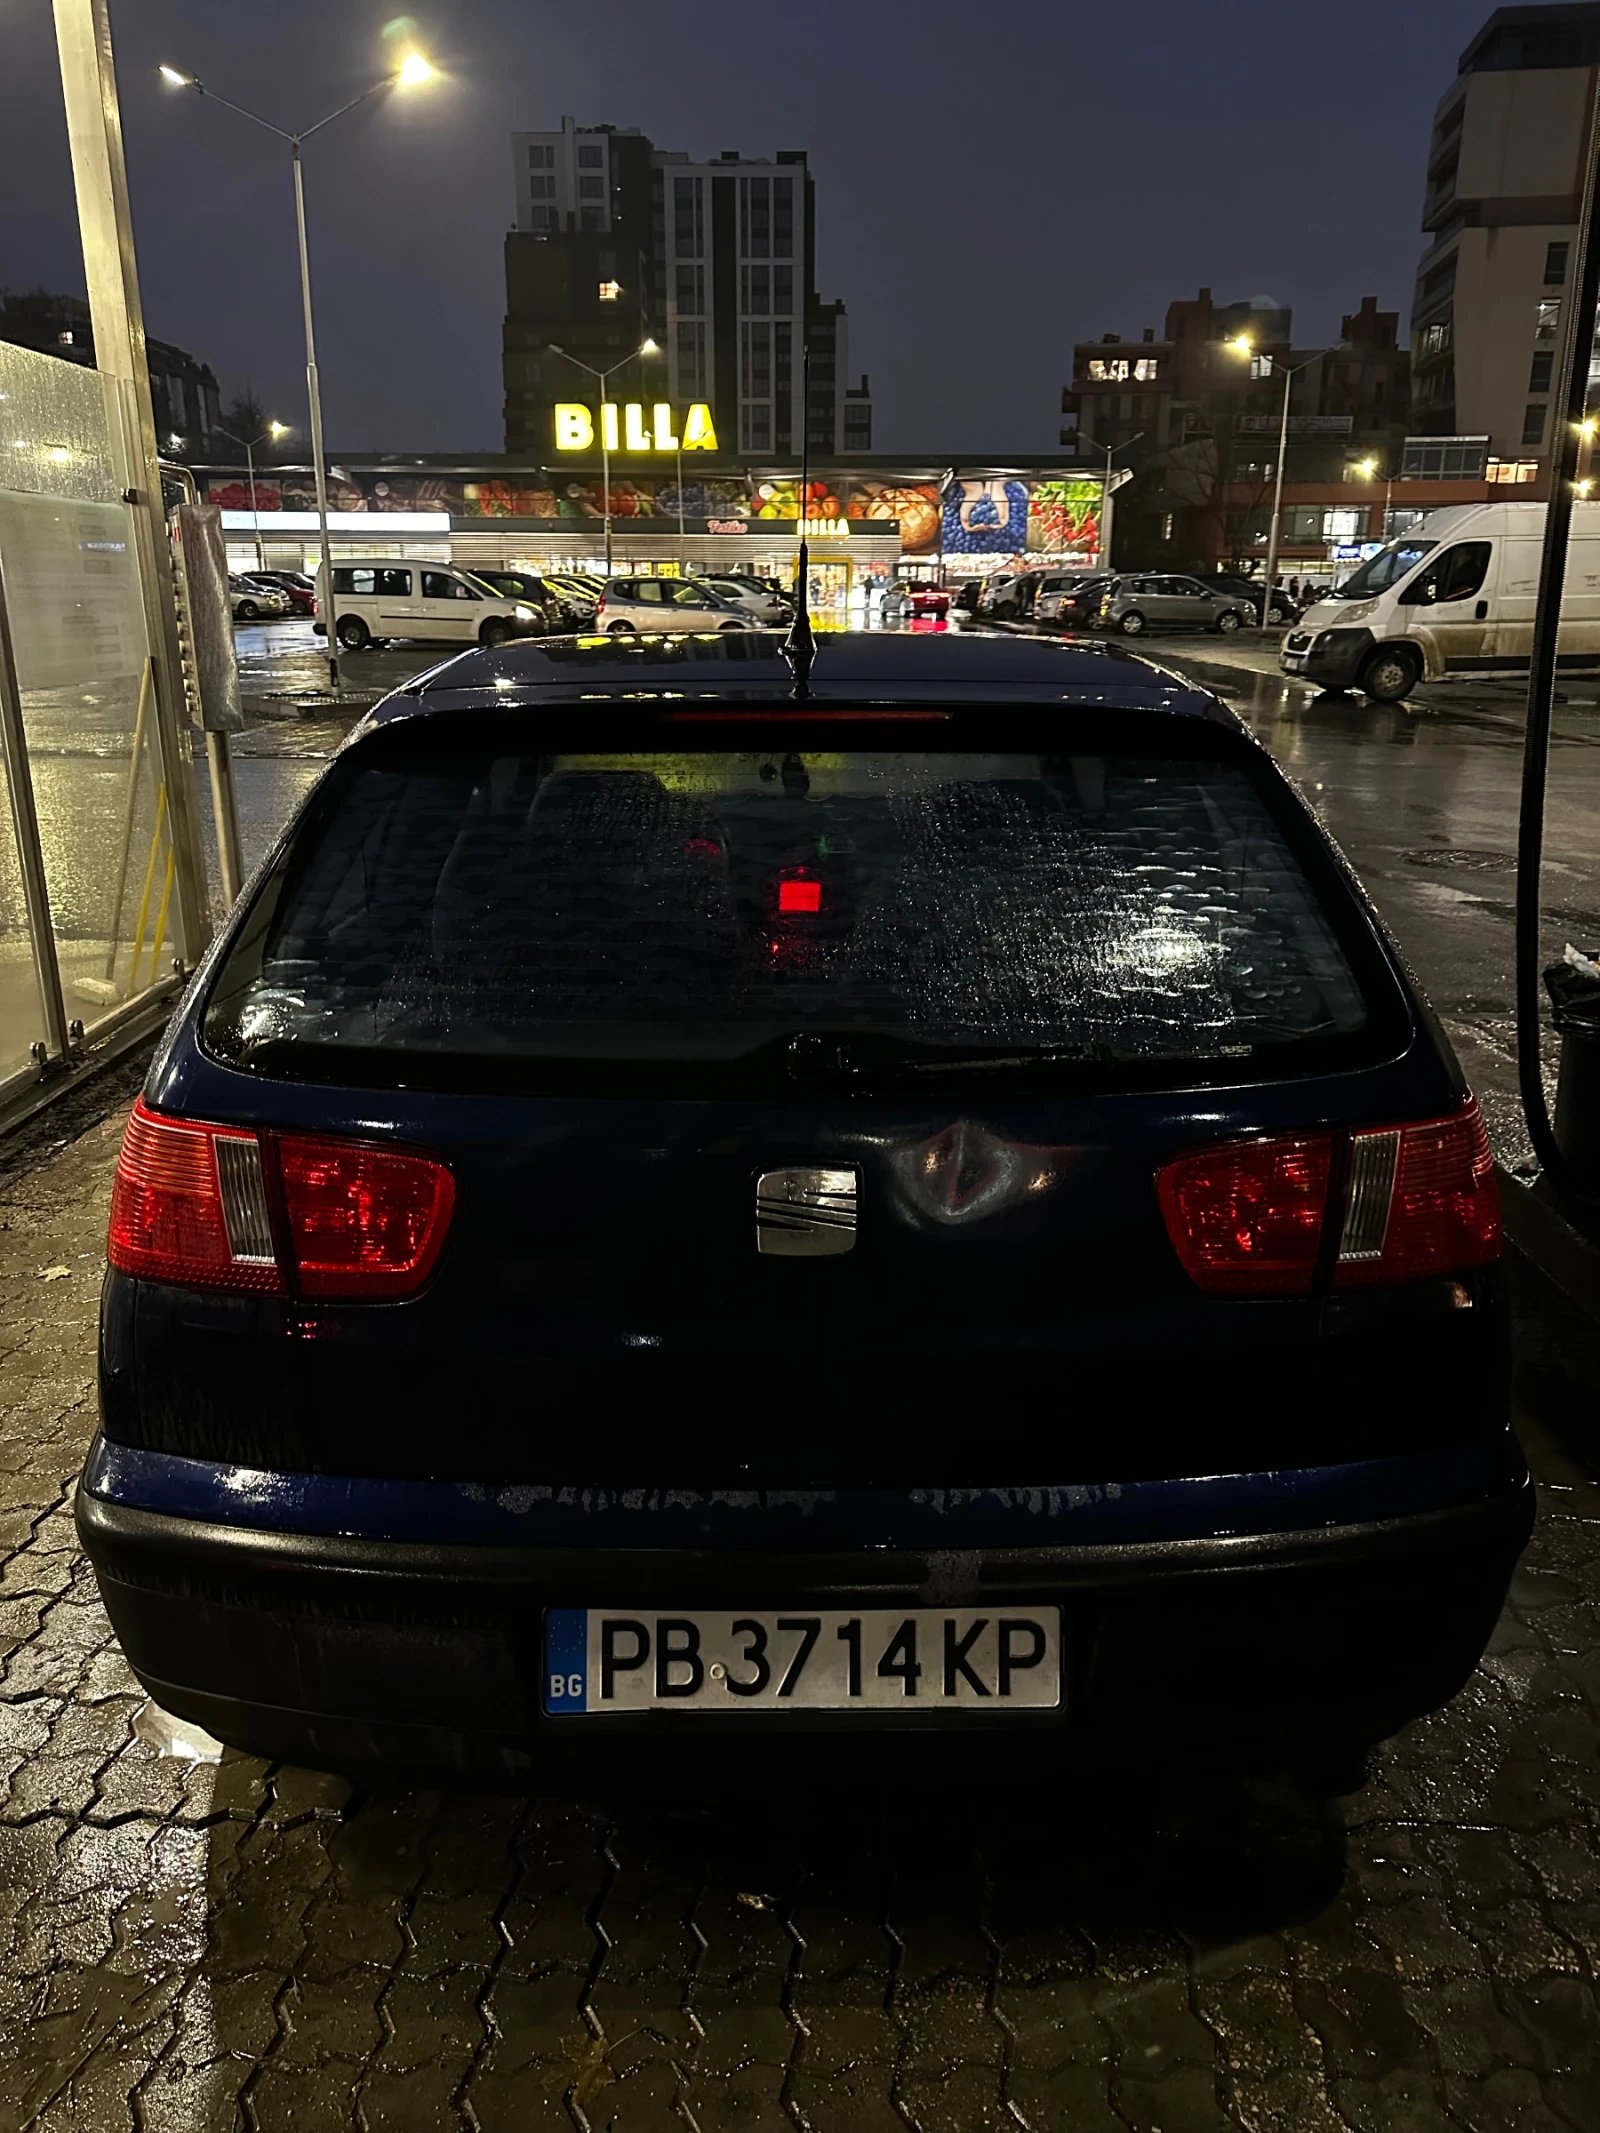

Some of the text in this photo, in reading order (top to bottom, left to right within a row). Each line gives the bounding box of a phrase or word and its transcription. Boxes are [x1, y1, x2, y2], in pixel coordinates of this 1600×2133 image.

[554, 403, 719, 450] BILLA
[796, 518, 850, 536] BILLA
[550, 1674, 582, 1698] BG
